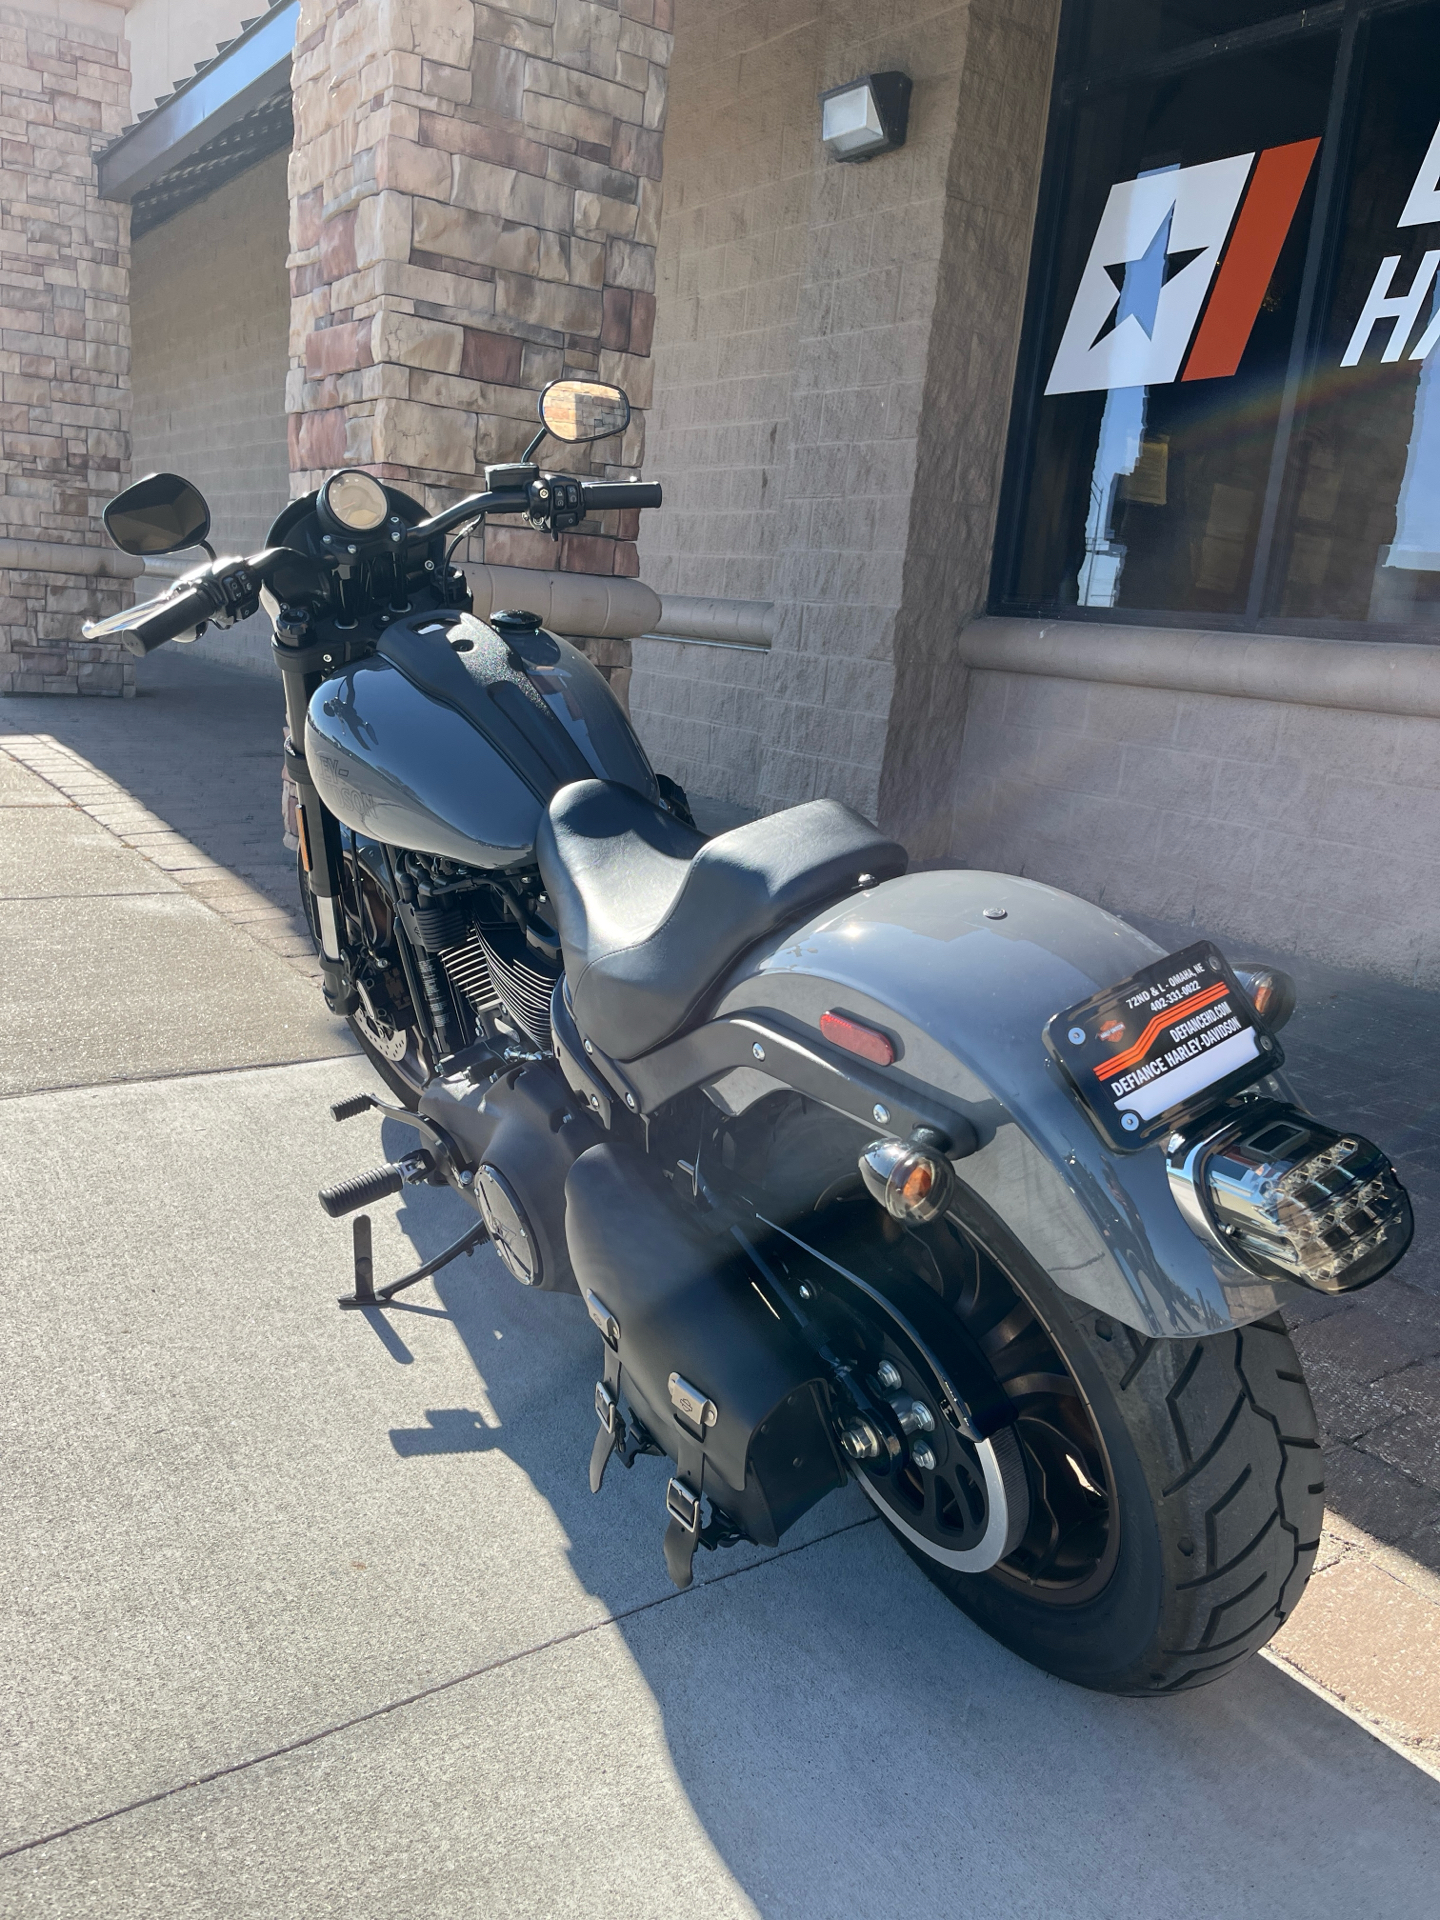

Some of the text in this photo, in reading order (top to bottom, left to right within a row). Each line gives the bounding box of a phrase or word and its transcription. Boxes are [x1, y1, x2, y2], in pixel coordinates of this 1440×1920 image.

[1125, 991, 1151, 1009] 72ND
[1149, 986, 1160, 997] &
[1157, 983, 1166, 993] L
[1168, 968, 1198, 987] OMAHA,
[1192, 962, 1206, 974] NE
[1150, 980, 1201, 1012] 402-331-0022
[1169, 1001, 1233, 1043] DEFIANCEHD.COM
[1110, 1016, 1243, 1097] DEFIANCE HARLEY-DAVIDSON
